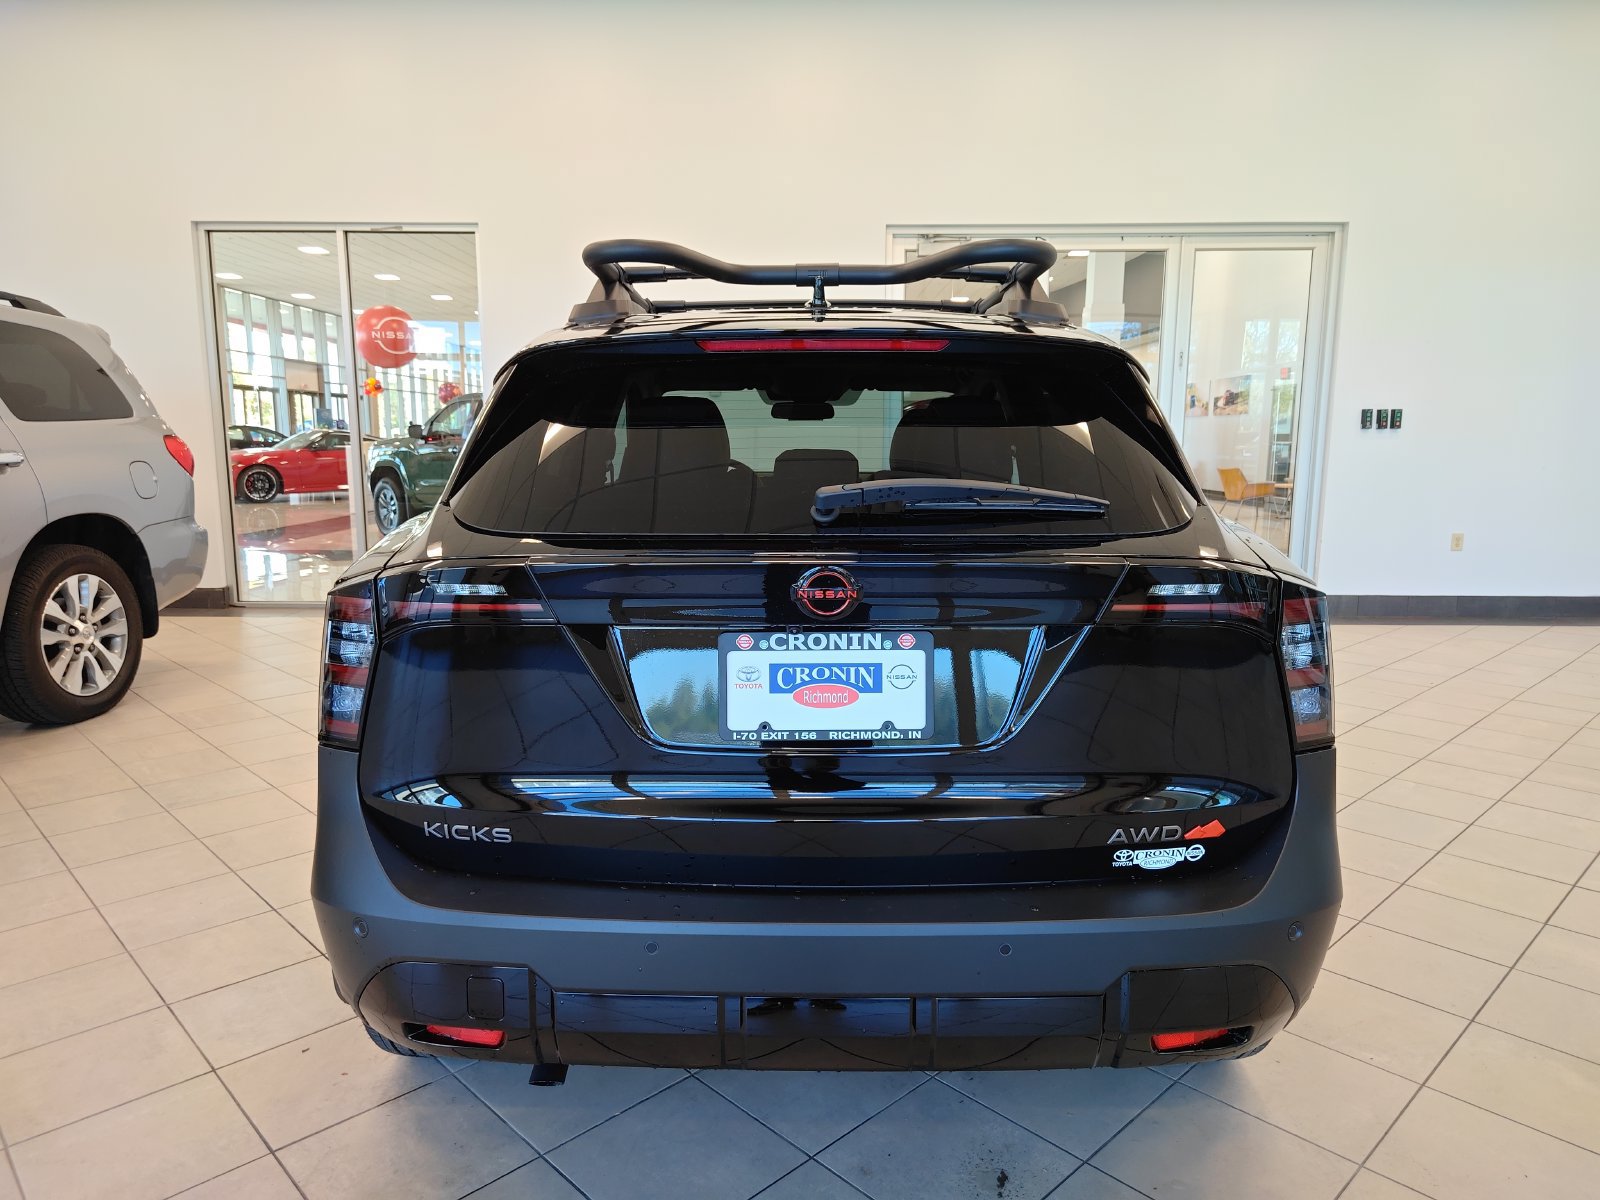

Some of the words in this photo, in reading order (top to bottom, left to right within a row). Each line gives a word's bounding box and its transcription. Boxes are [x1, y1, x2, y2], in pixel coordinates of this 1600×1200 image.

[371, 331, 412, 339] NISSA
[797, 590, 857, 599] NISSAN
[769, 633, 882, 650] CRONIN
[776, 666, 875, 689] CRONIN
[803, 690, 849, 704] Richmond
[733, 732, 757, 740] I-70
[761, 732, 789, 740] EXIT
[794, 732, 817, 740] 156
[829, 731, 904, 740] RICHMOND,
[908, 731, 922, 739] IN
[423, 821, 512, 844] KICKS
[1107, 825, 1182, 844] AWD
[1135, 848, 1184, 861] CRONIN
